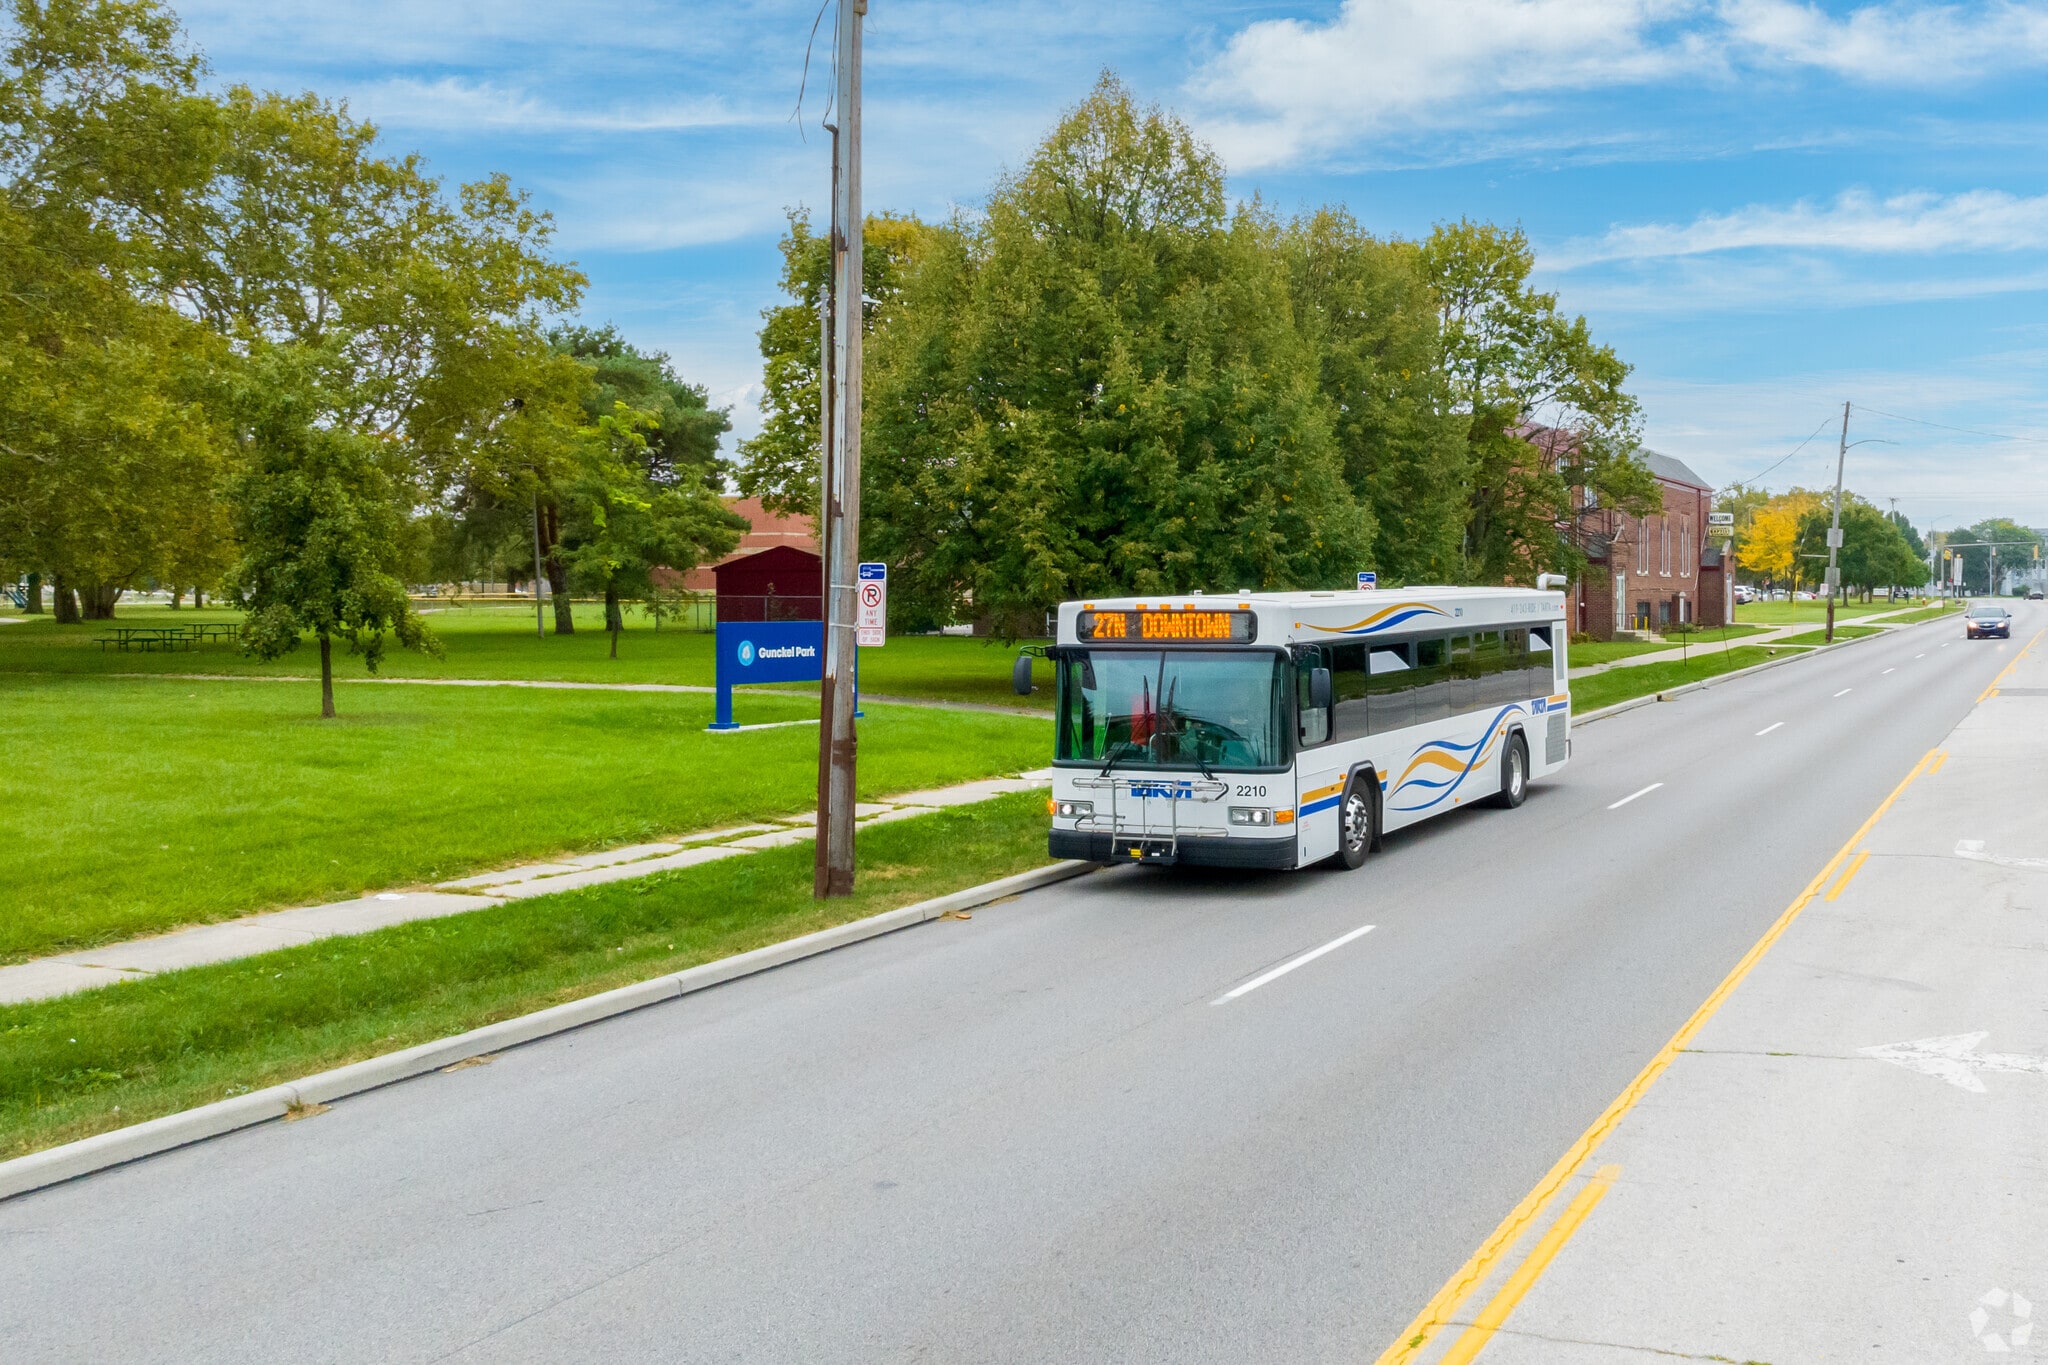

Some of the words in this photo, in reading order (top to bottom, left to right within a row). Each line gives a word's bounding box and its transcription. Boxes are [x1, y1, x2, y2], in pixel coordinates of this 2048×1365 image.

[1093, 613, 1126, 638] 27N
[1142, 613, 1231, 639] DOWNTOWN
[758, 646, 795, 659] Gunckel
[795, 645, 815, 658] Park
[1236, 785, 1267, 797] 2210
